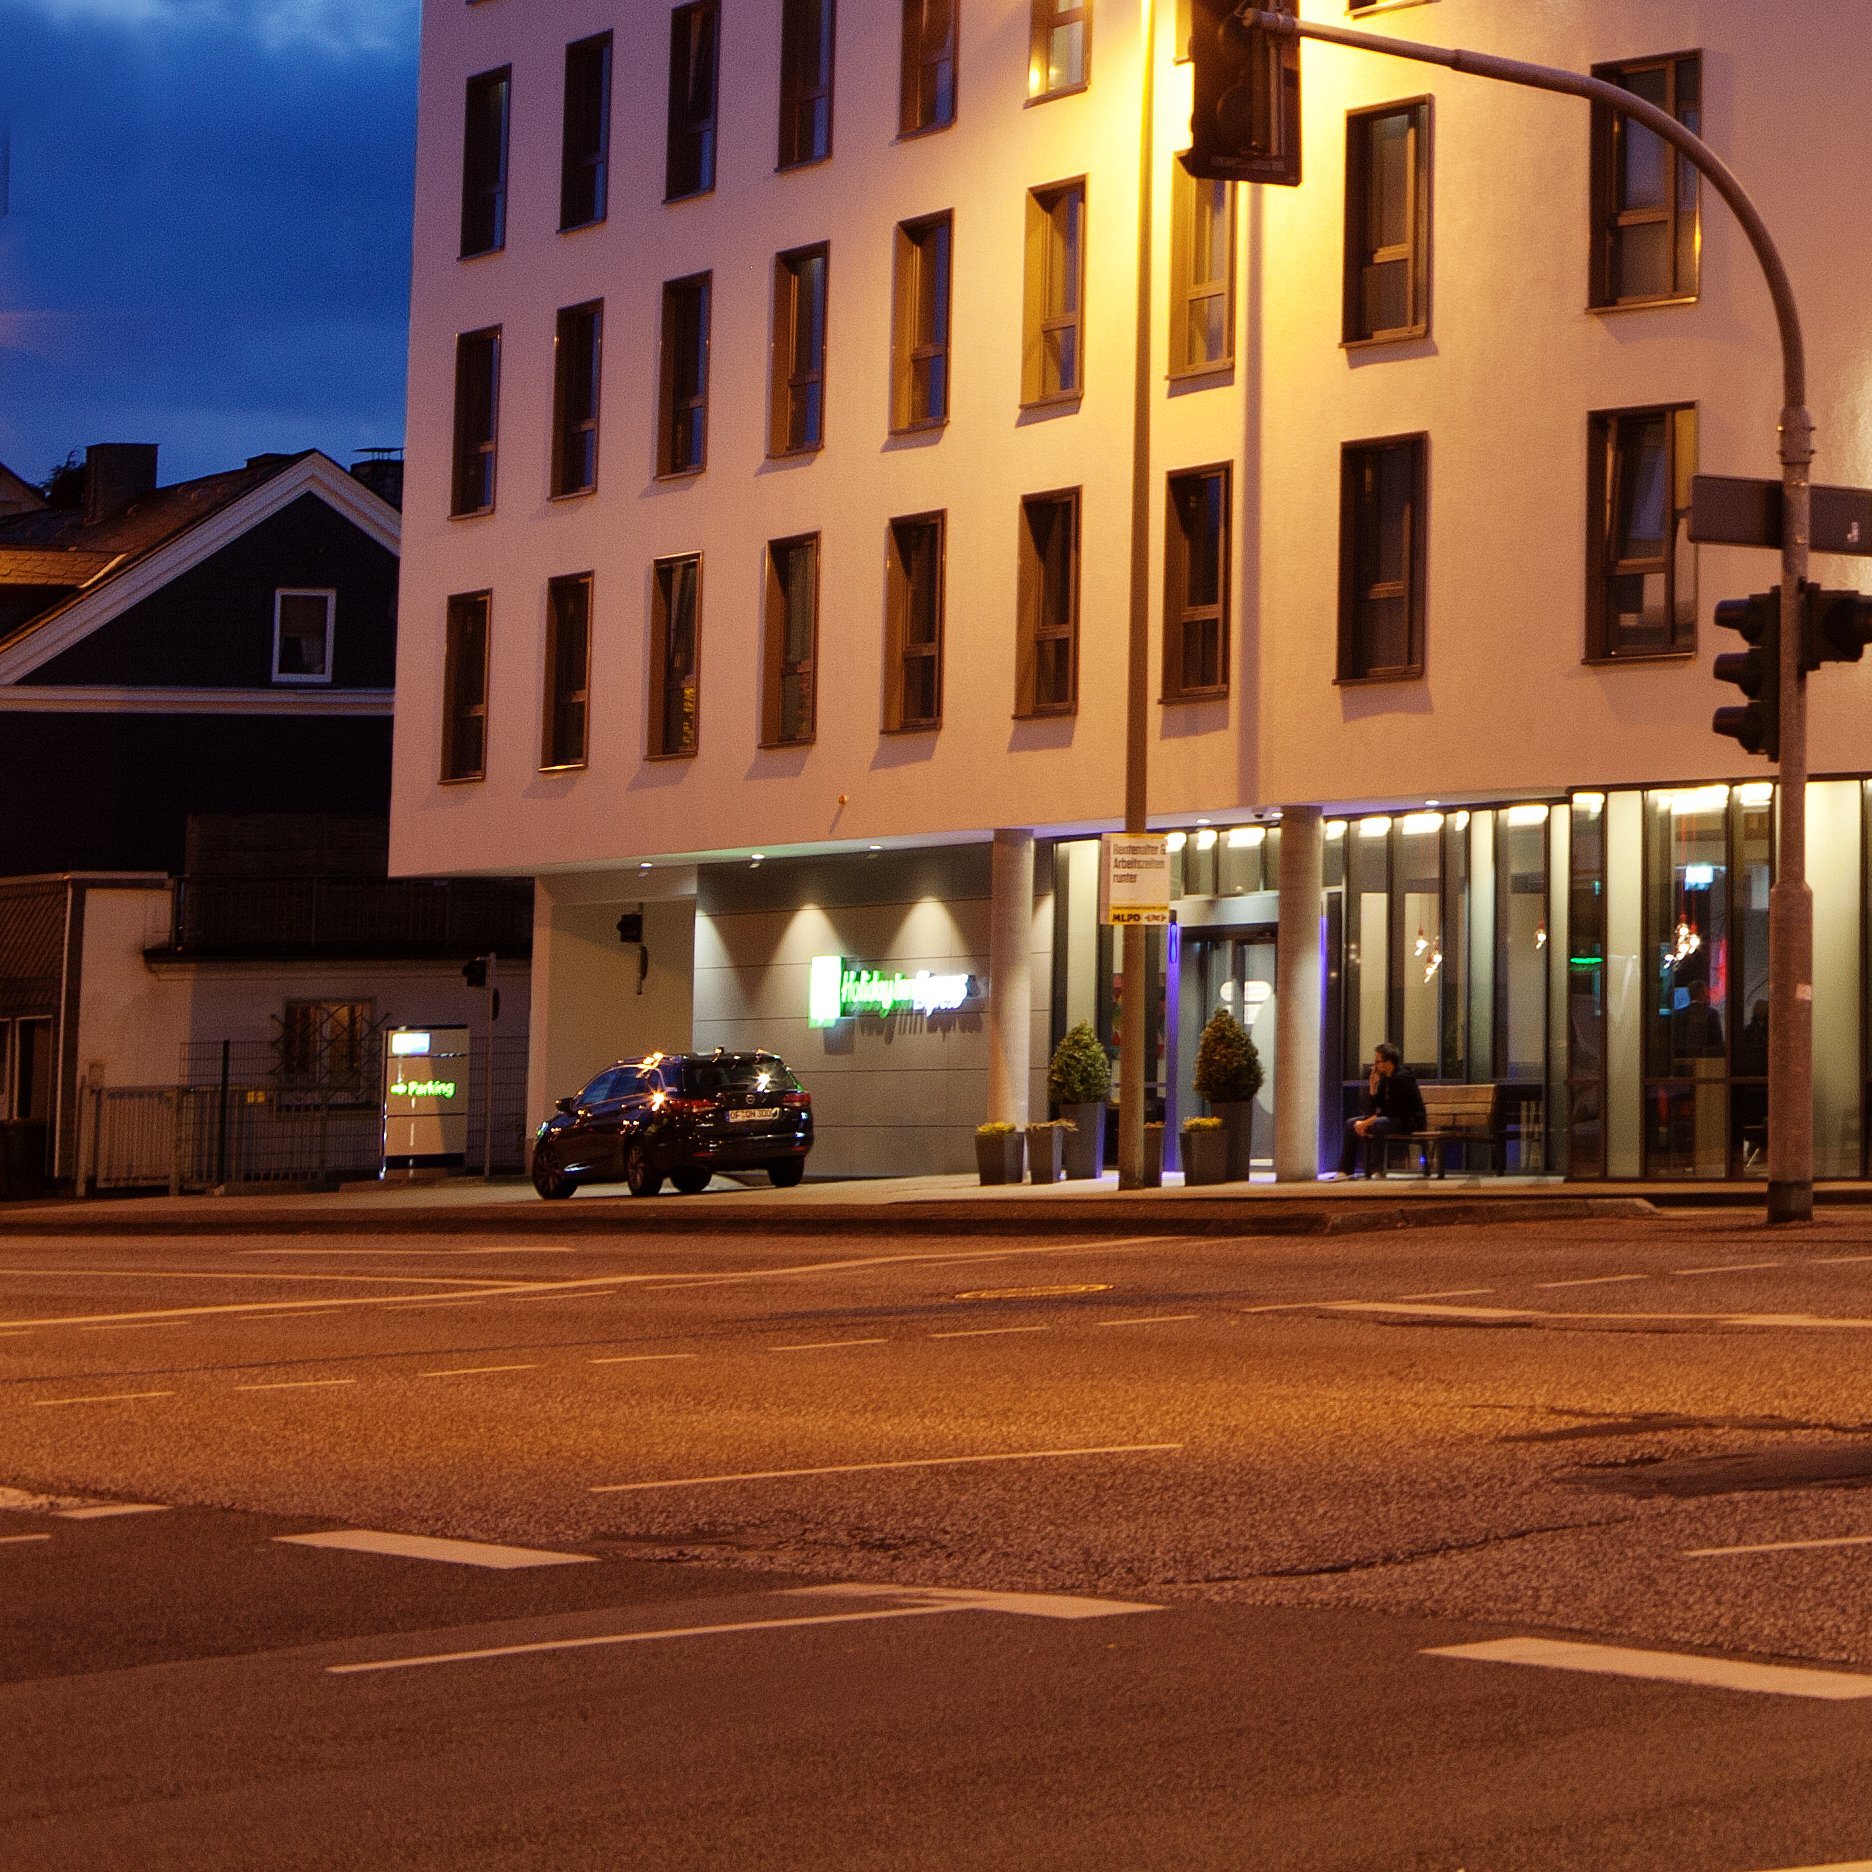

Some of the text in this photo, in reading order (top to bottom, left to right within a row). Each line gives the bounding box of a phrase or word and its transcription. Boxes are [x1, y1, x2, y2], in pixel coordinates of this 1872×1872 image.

[1113, 843, 1159, 855] Rentenalter
[1112, 857, 1165, 869] Arbeitszeiten
[1112, 872, 1138, 883] runter
[1112, 913, 1141, 923] MLPD
[841, 969, 893, 1010] Holiday
[407, 1079, 457, 1099] Parking
